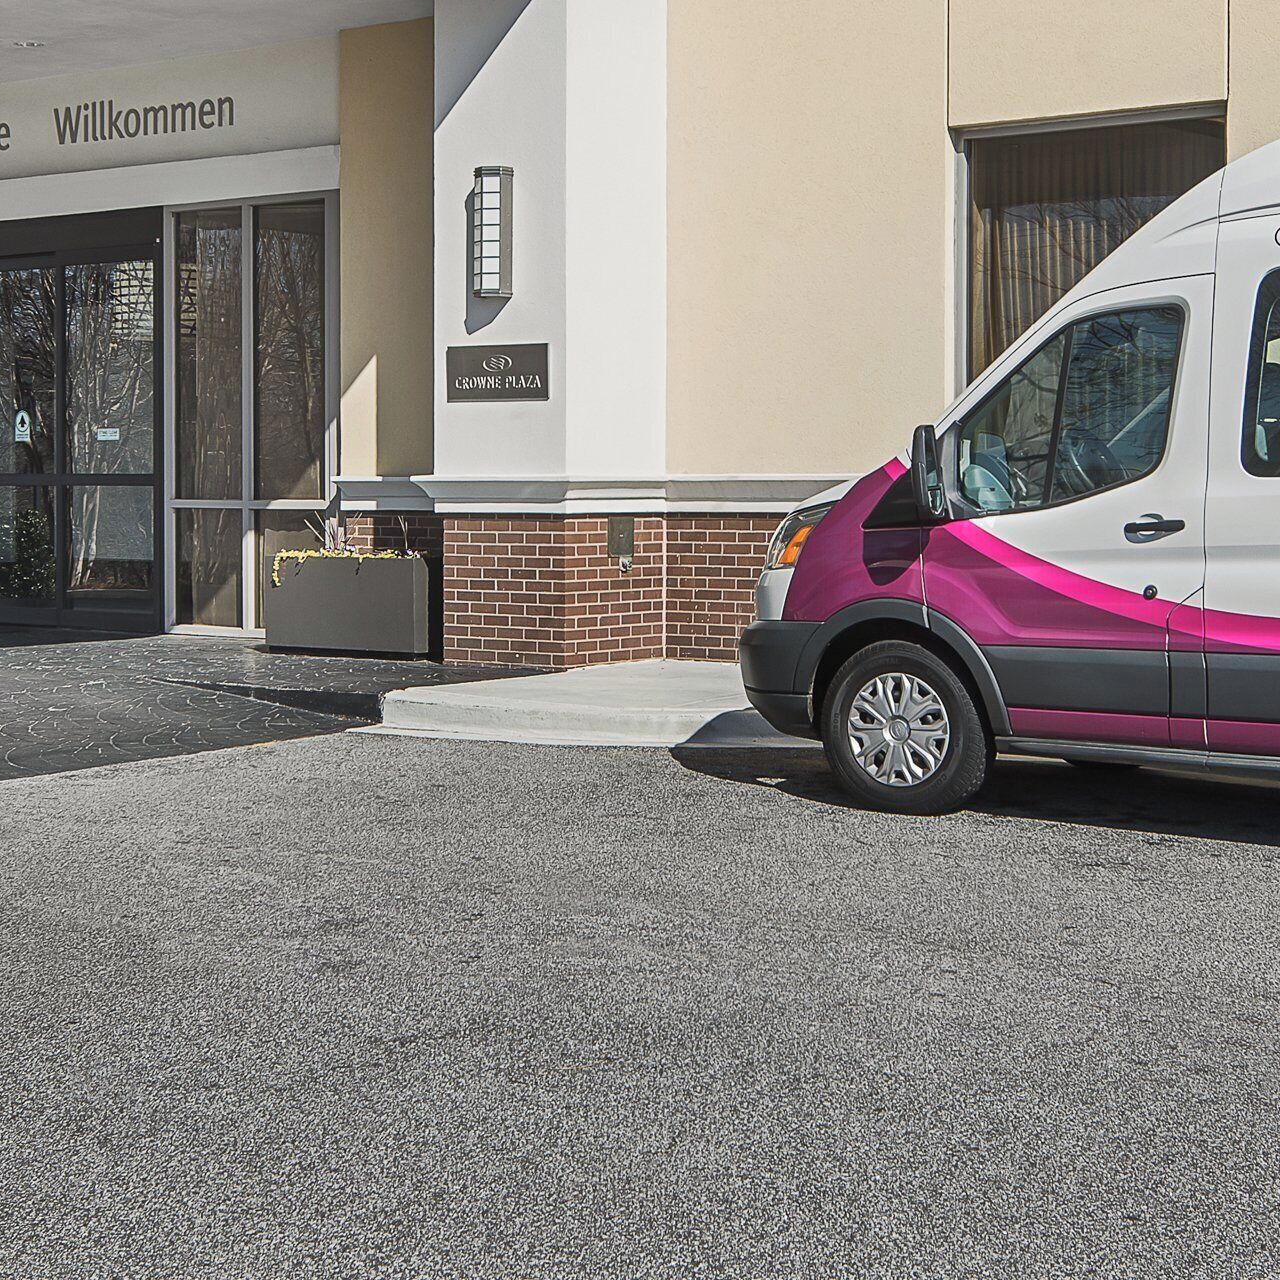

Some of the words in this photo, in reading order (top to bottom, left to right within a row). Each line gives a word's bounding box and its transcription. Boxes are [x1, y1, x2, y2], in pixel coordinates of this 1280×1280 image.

[53, 95, 235, 145] Willkommen
[455, 375, 502, 390] CROWNE
[505, 374, 542, 389] PLAZA
